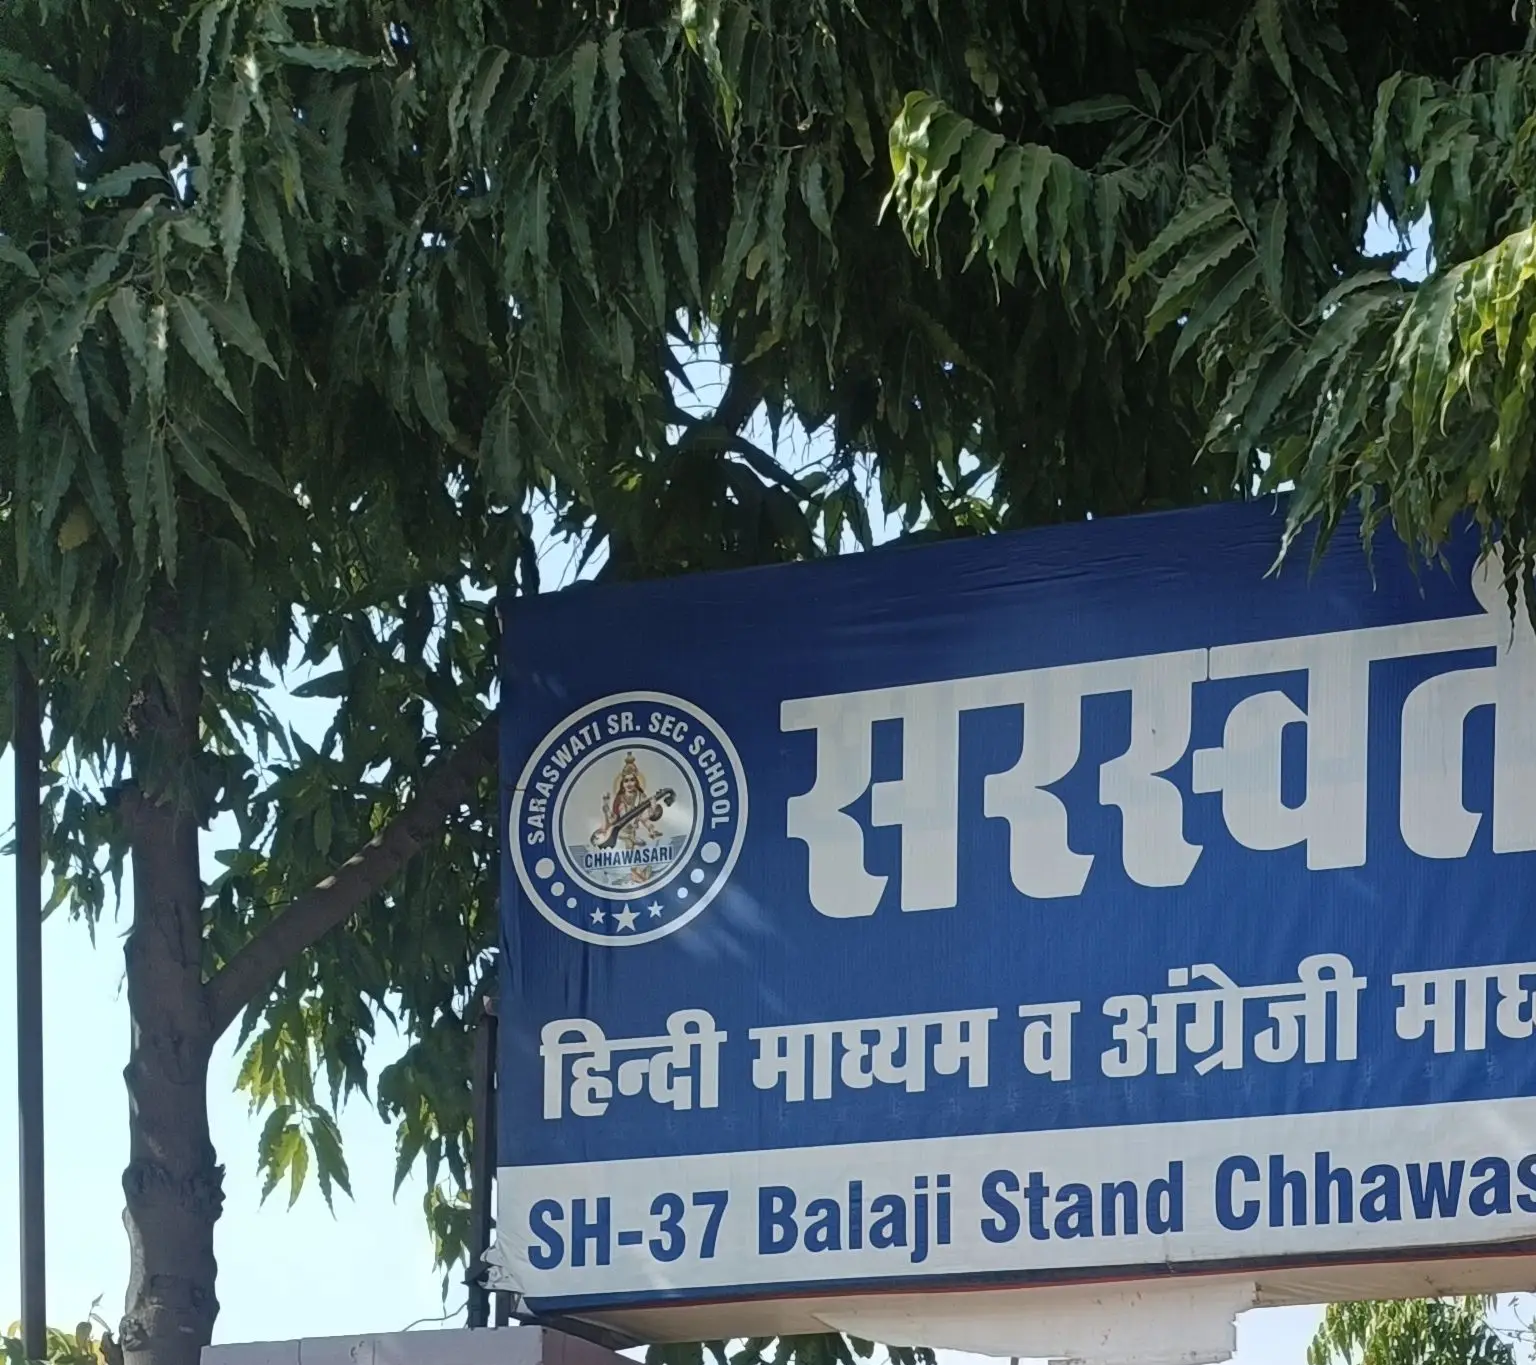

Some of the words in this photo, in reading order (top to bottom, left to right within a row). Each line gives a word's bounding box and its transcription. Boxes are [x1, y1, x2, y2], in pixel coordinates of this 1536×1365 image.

[527, 721, 603, 845] SARASWATI
[607, 711, 641, 735] SR.
[648, 711, 689, 743] SEC
[688, 735, 731, 829] SCHOOL
[584, 846, 673, 869] CHHAWASARI
[540, 1008, 727, 1119] हिन्दी
[1019, 1000, 1081, 1082] व
[1101, 953, 1367, 1077] अंग्रेजी
[527, 1190, 729, 1270] SH-37
[758, 1174, 951, 1263] Balaji
[980, 1160, 1184, 1244] Stand
